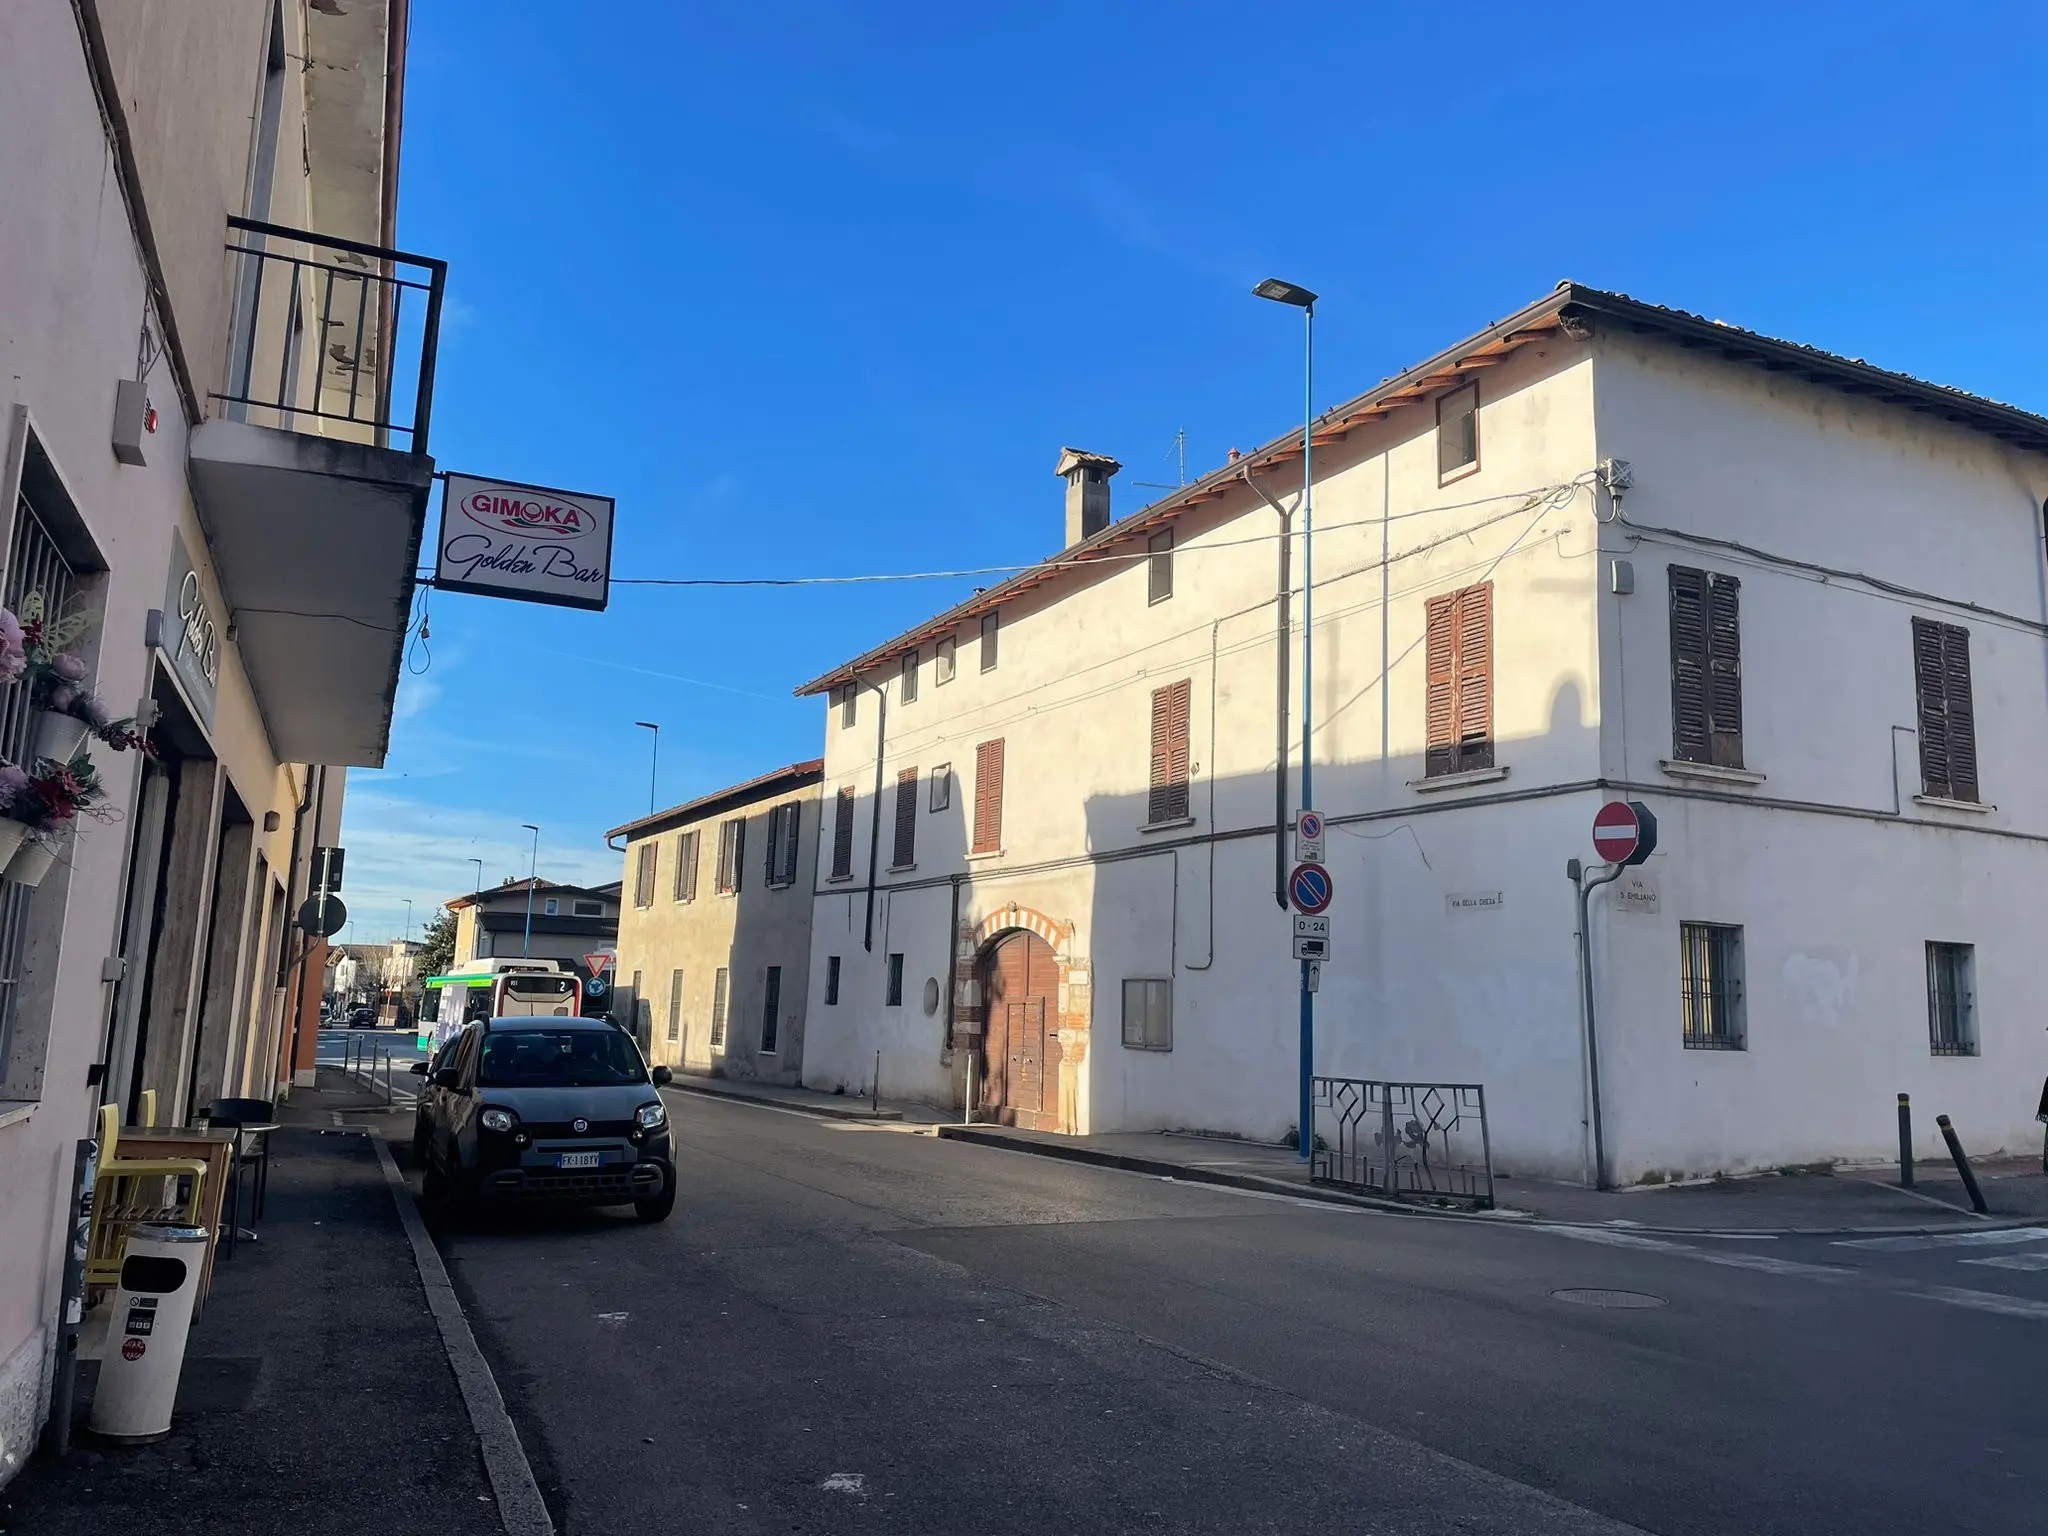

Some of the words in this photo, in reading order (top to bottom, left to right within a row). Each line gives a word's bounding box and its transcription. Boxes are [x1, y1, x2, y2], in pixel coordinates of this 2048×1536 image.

[471, 494, 581, 525] GIMOKA
[444, 534, 537, 581] Golden
[532, 545, 604, 584] Bar
[1631, 880, 1644, 889] VIA
[1313, 922, 1325, 932] 24
[559, 981, 566, 992] 2
